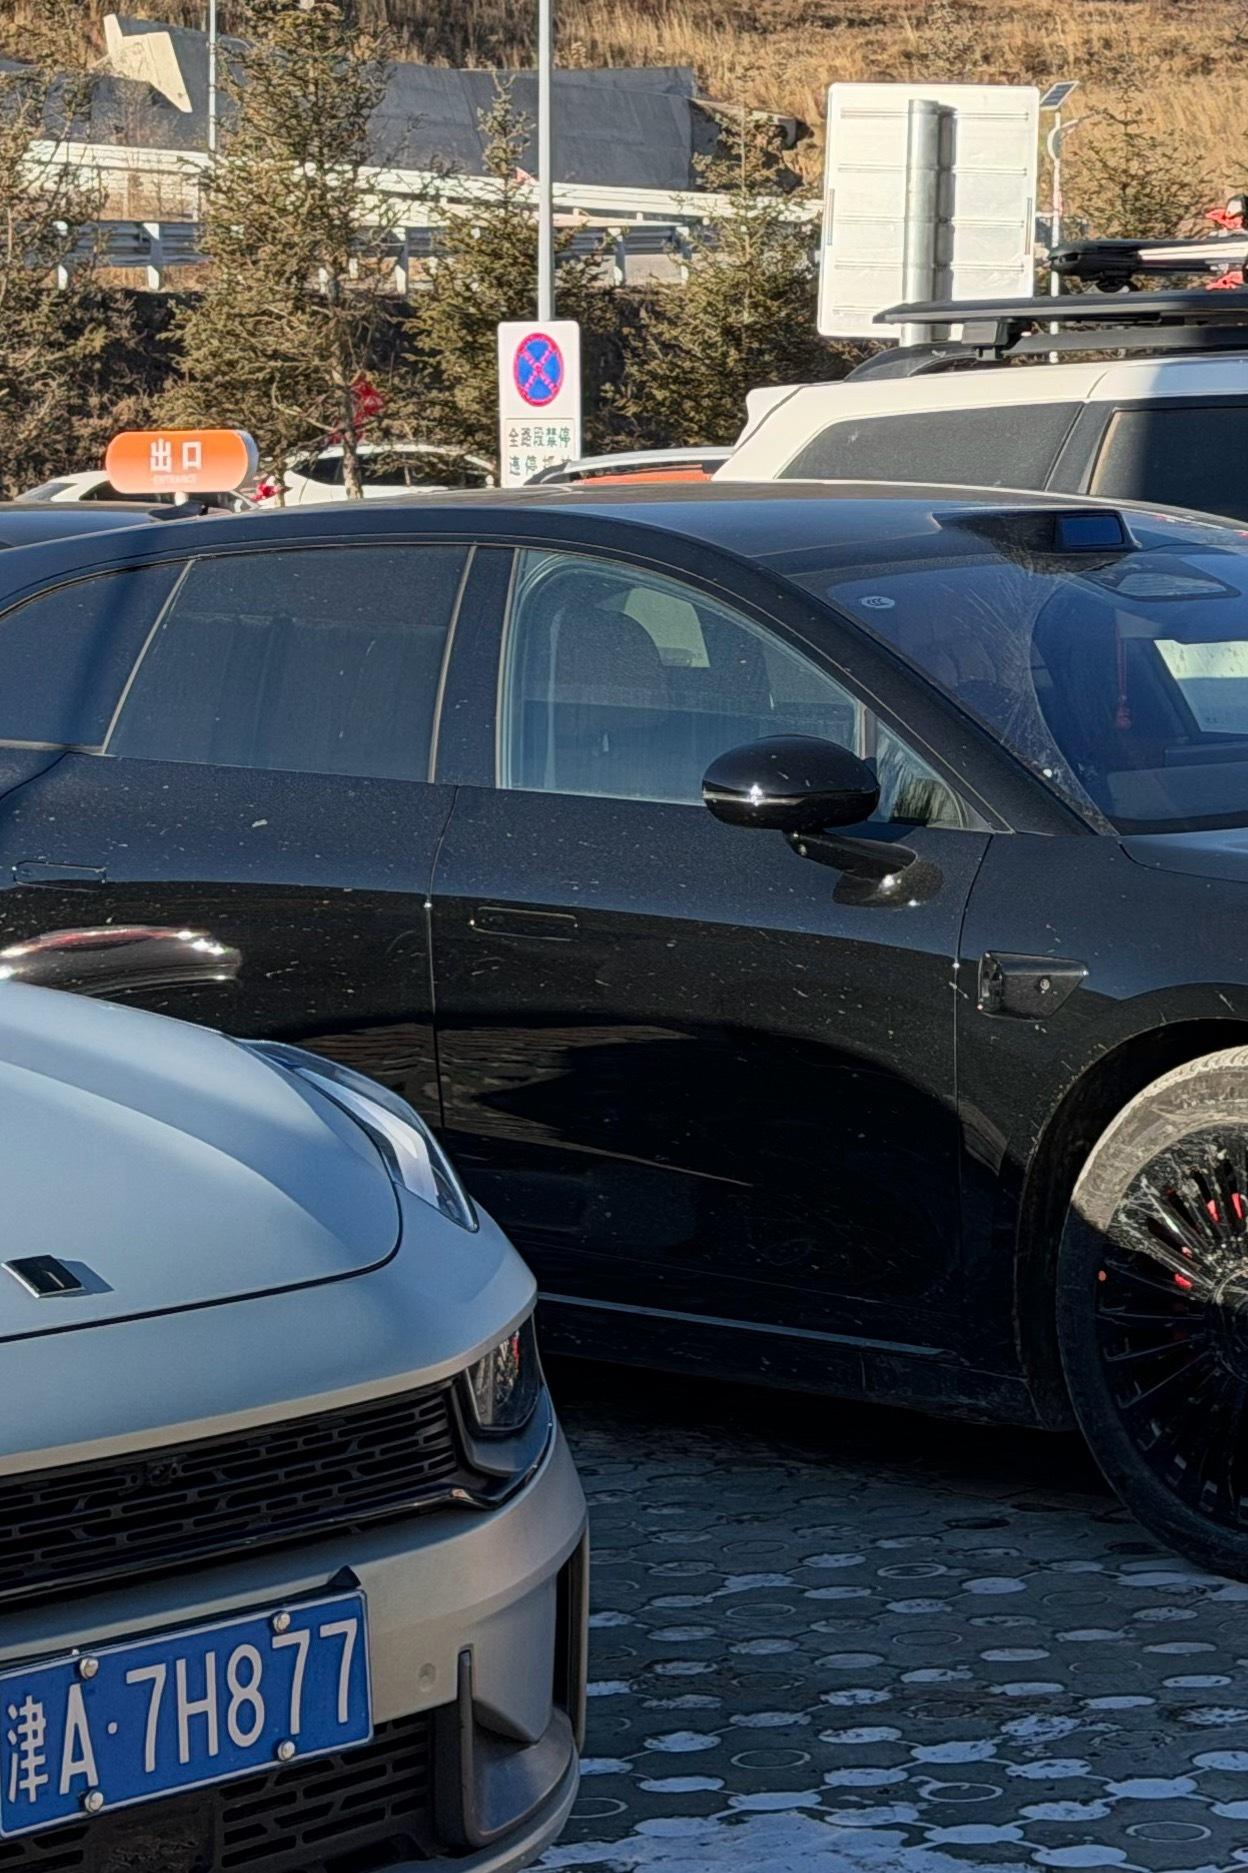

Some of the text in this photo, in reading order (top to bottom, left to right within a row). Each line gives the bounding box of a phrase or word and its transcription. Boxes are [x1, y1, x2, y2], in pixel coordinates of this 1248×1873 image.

[508, 426, 571, 448] 全路段禁停
[150, 438, 202, 472] 出口
